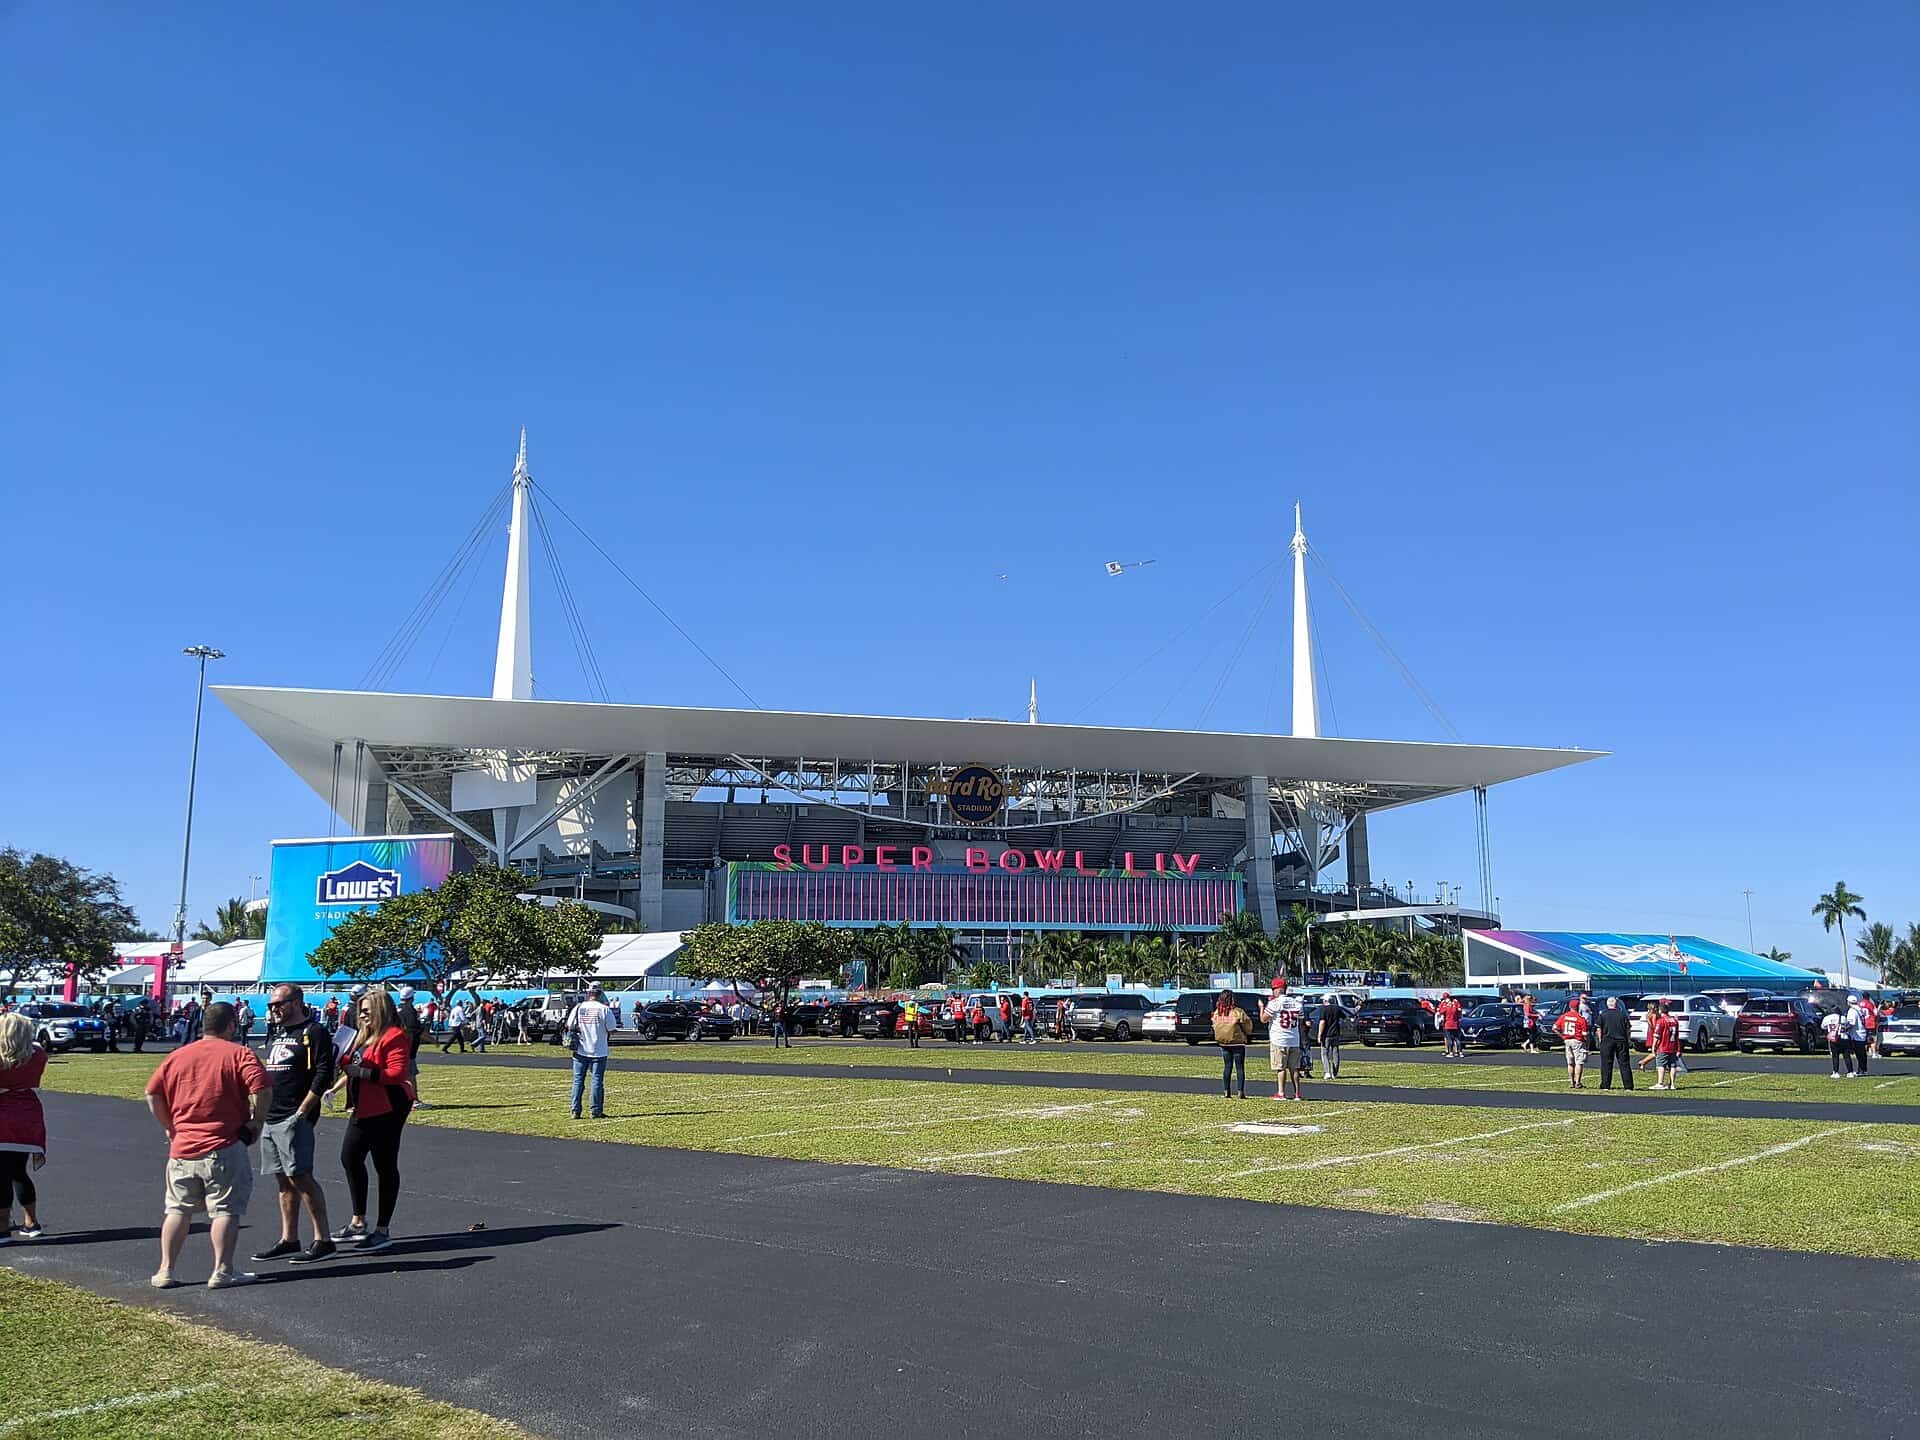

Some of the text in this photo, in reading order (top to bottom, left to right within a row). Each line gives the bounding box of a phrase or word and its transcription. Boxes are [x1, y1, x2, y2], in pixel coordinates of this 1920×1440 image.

[926, 775, 1023, 801] Hard Rock
[957, 804, 992, 812] STADIUM
[773, 844, 1200, 877] SUPER BOWL LIV
[325, 878, 394, 900] LOWE'S
[1280, 1010, 1299, 1028] 85
[1564, 1021, 1576, 1035] 15
